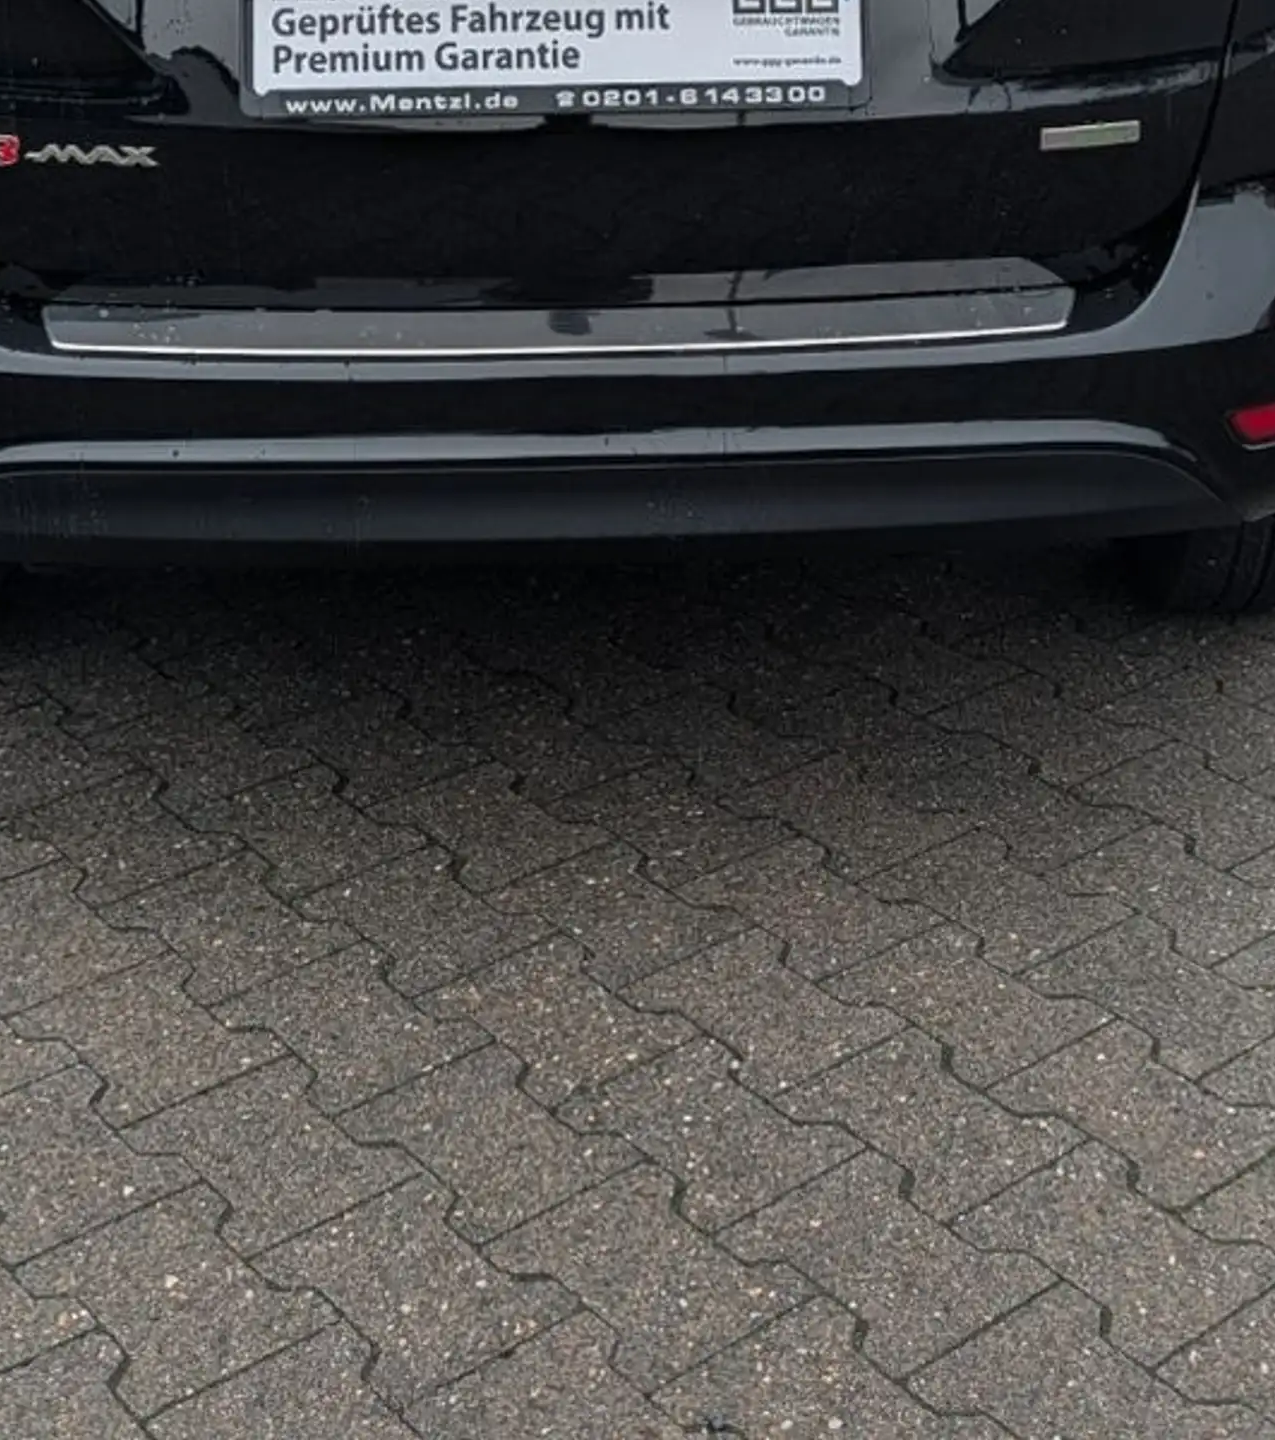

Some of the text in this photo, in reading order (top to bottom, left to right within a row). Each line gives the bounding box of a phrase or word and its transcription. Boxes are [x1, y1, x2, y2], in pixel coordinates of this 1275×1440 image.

[271, 0, 671, 43] Geprüftes Fahrzeug mit
[272, 40, 581, 74] Premium Garantie
[285, 91, 519, 114] www.Mentzl.de
